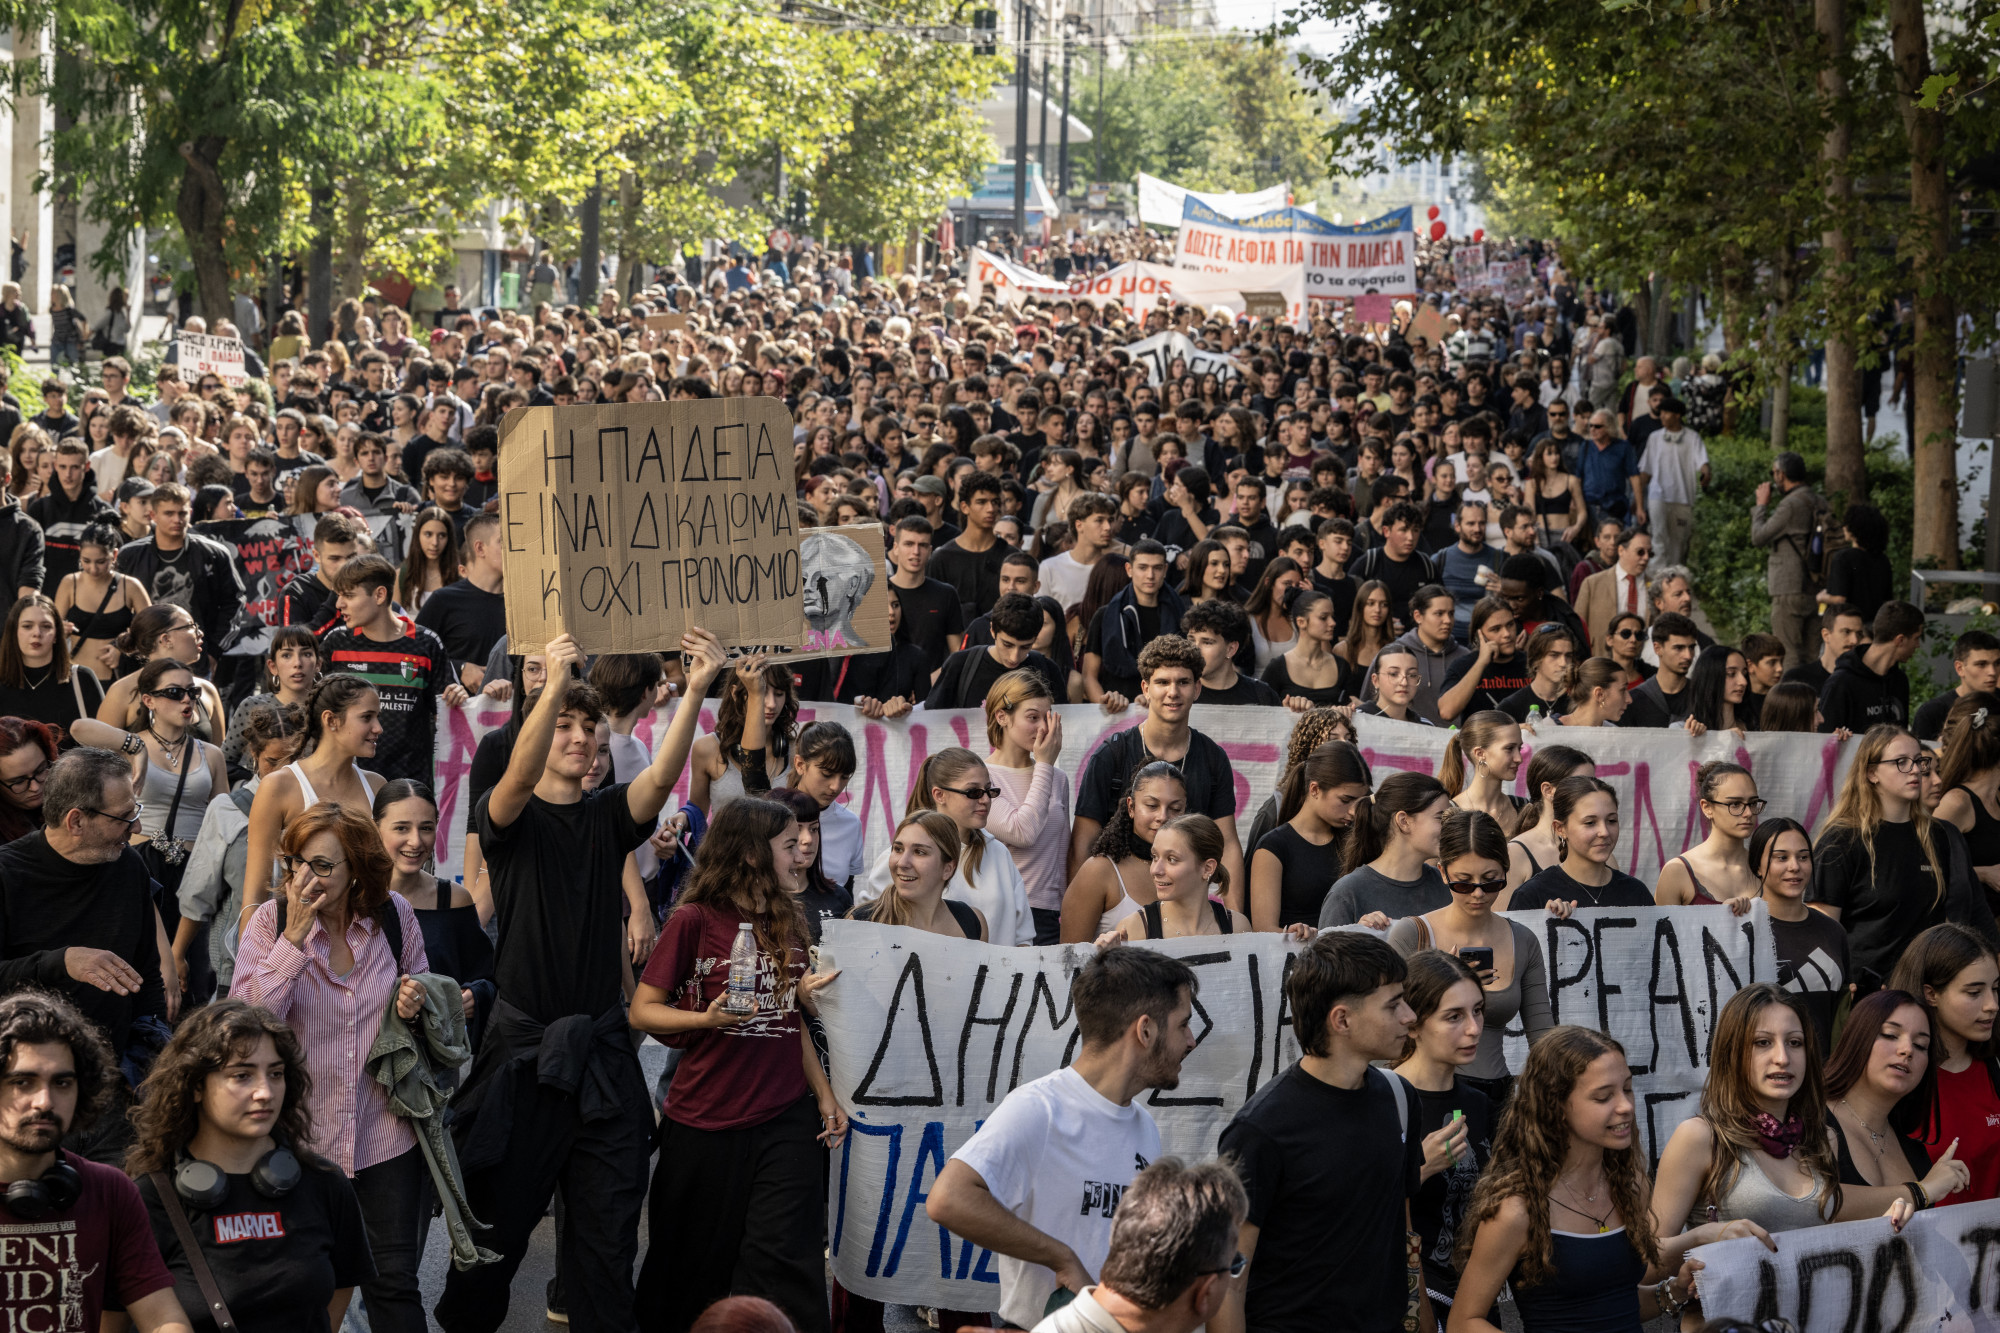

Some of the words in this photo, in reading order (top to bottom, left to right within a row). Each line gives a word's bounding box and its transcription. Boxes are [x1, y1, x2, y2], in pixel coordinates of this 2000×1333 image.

[1184, 229, 1223, 260] ΔΩΣΤΕ
[1227, 238, 1276, 264] ΛΕΦΤΑ
[1310, 241, 1340, 268] ΤΗΝ
[1347, 239, 1405, 268] ΠΑΙΔΕΙΑ
[1120, 276, 1172, 297] μας
[1329, 277, 1344, 286] τα
[543, 429, 575, 487] Η
[598, 422, 781, 484] ΠΑΙΔΕΙΑ
[505, 491, 613, 556] ΕΙΝΑΙ
[630, 491, 793, 552] ΔΙΚΑΙΩΜΑ
[236, 536, 286, 559] WHY
[579, 560, 643, 617] ΟΧΙ
[661, 548, 799, 610] ΠΡΟΝΟΜΙΟ
[1080, 1180, 1130, 1219] PU
[216, 1213, 284, 1242] MARVEL
[0, 1233, 78, 1266] ENI
[0, 1268, 71, 1302] IDI
[0, 1304, 70, 1333] ICI
